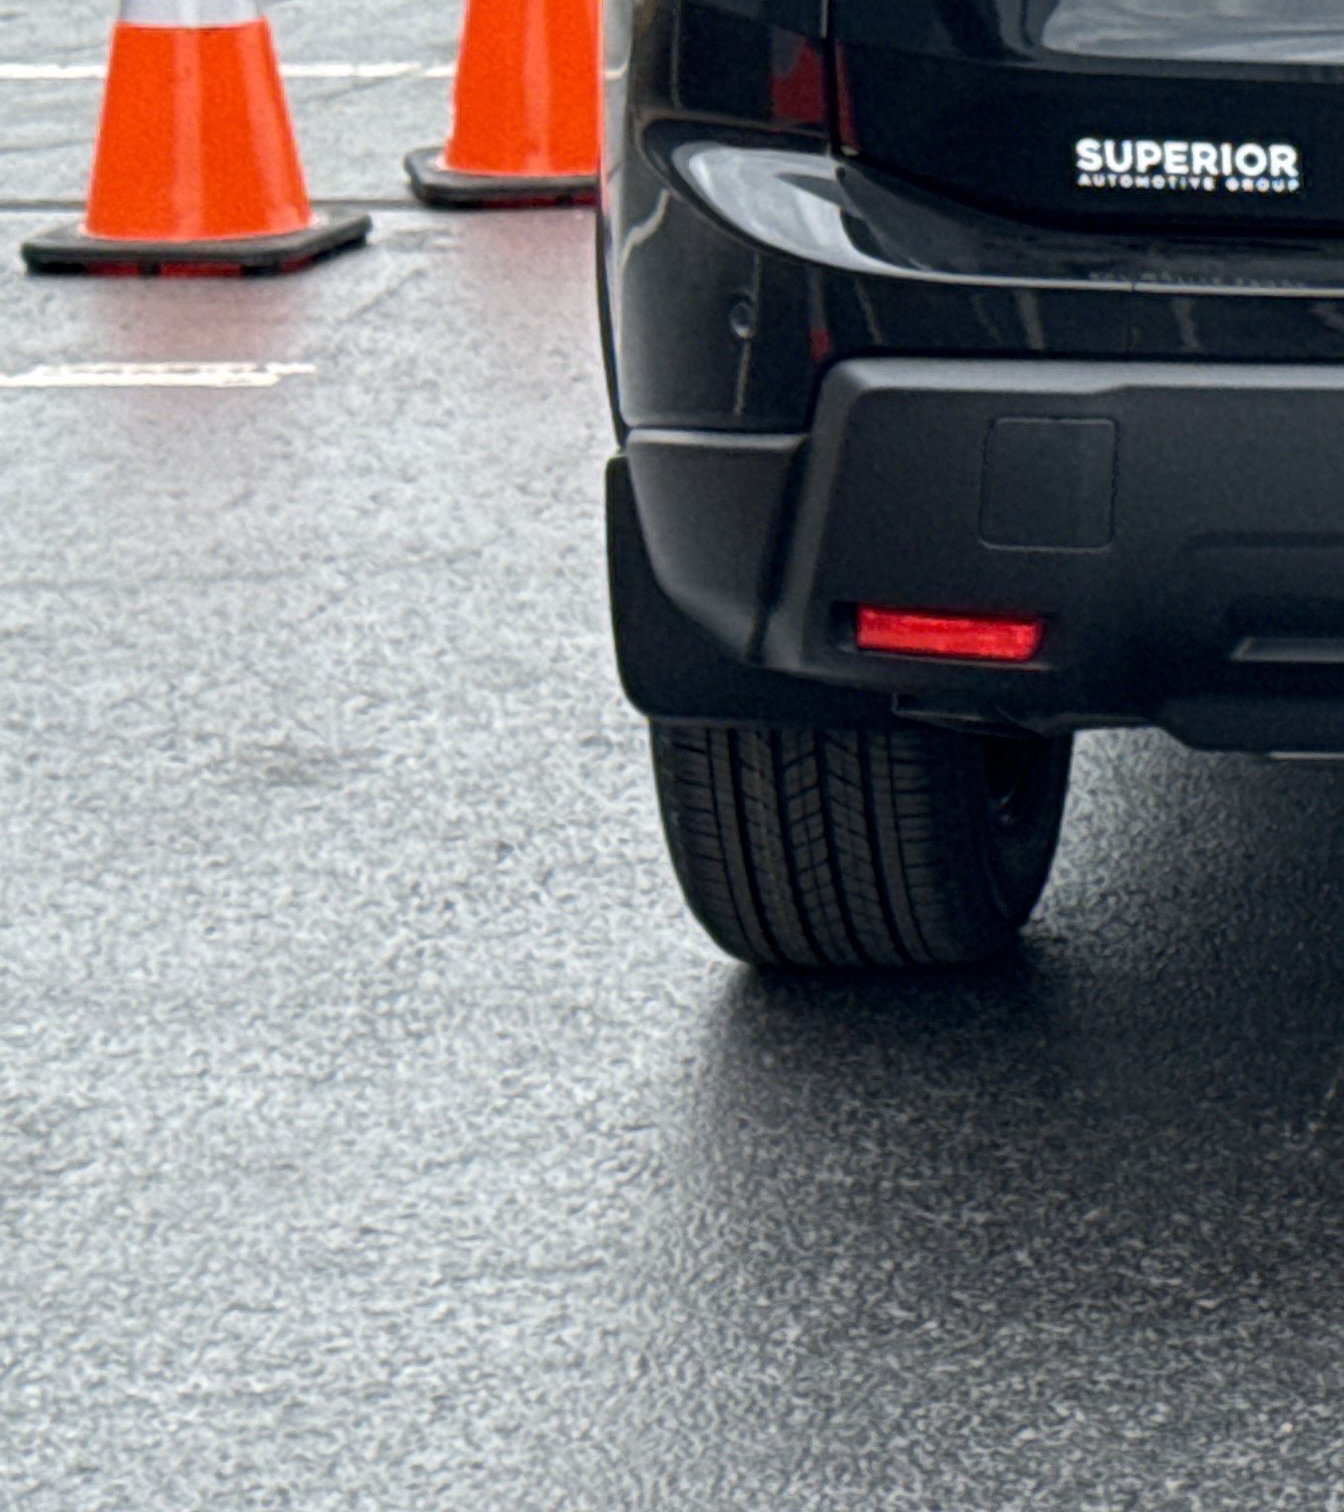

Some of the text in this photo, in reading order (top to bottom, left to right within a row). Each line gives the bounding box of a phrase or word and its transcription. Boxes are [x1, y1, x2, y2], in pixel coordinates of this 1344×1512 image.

[1075, 138, 1299, 177] SUPERIOR
[1077, 173, 1300, 193] AUTOMOTIVE GROUP
